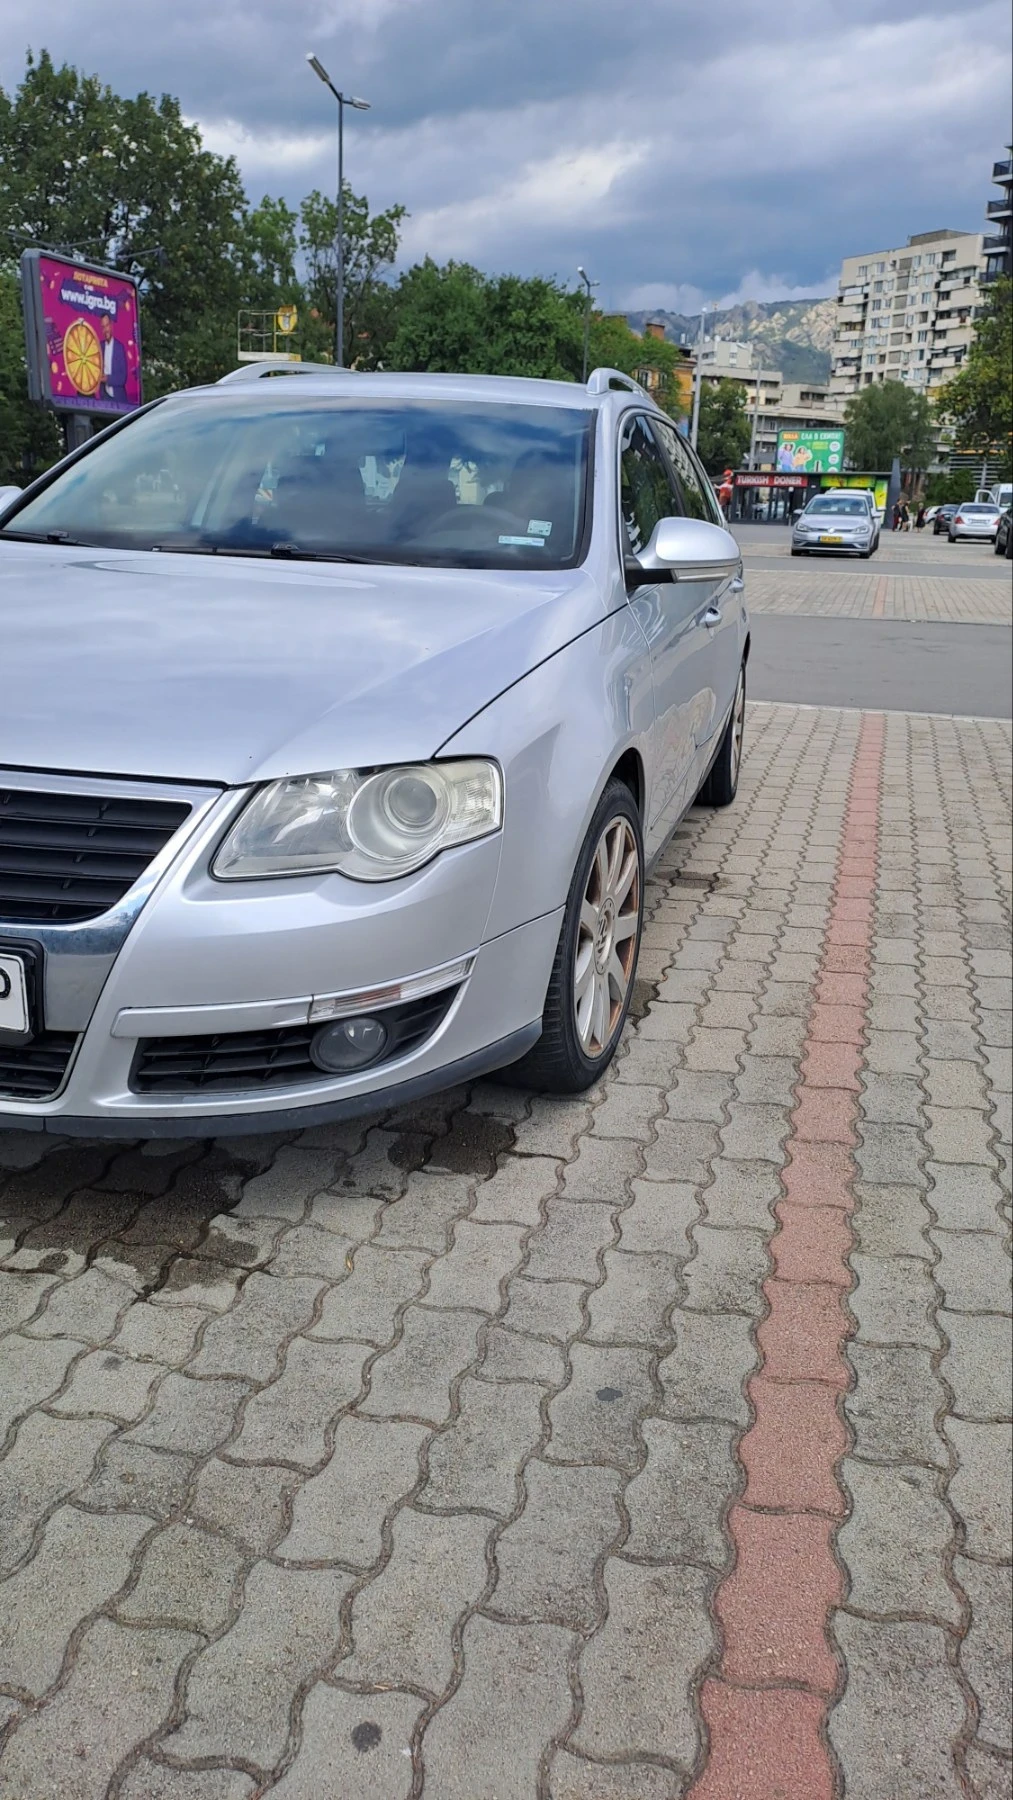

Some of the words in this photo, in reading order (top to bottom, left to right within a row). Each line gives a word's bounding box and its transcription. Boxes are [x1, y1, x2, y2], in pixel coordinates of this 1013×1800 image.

[61, 289, 116, 314] www.igra.bg
[737, 475, 769, 484] TURKISH
[773, 475, 802, 485] DONER
